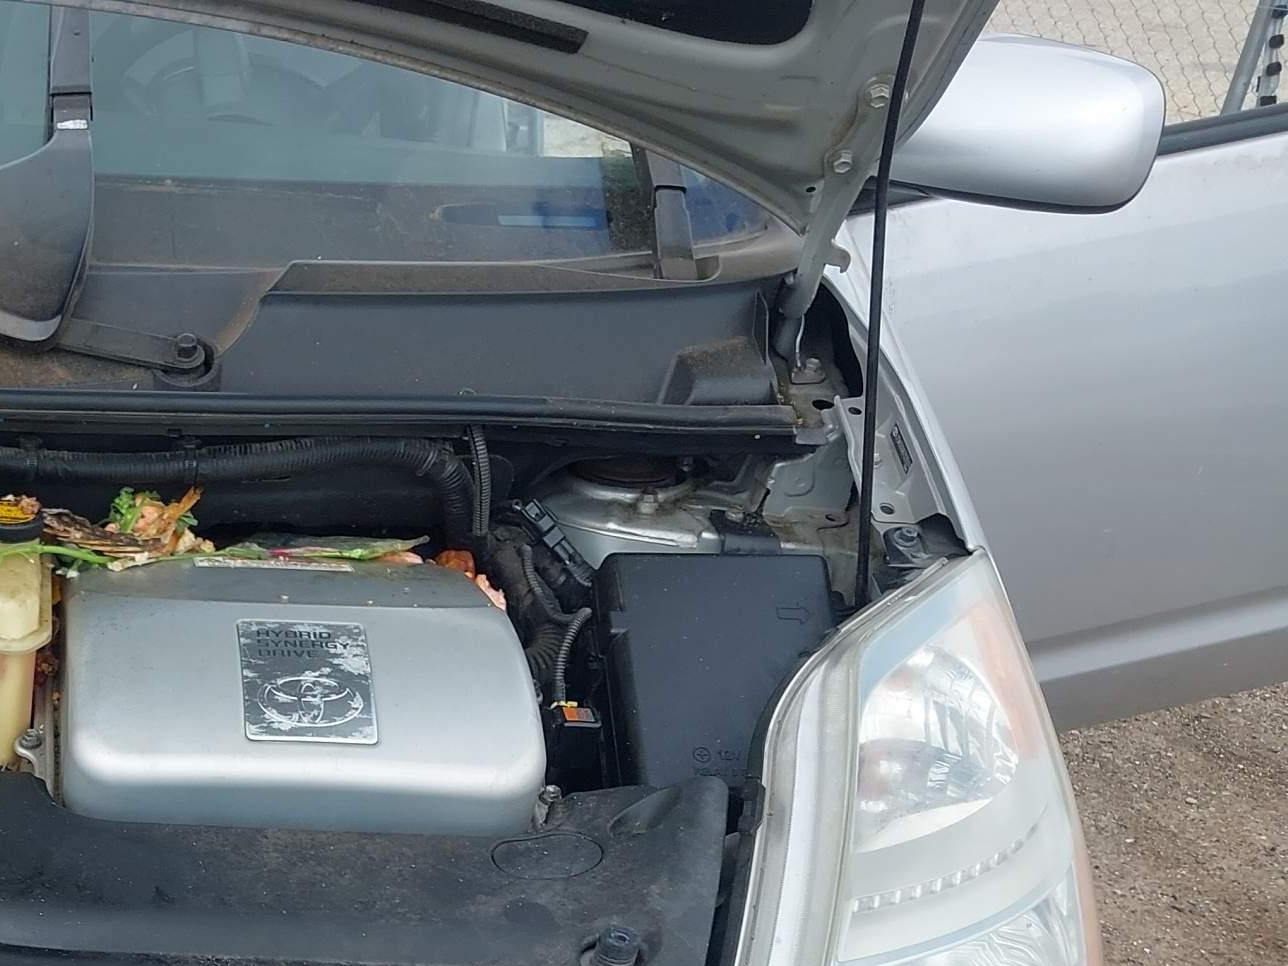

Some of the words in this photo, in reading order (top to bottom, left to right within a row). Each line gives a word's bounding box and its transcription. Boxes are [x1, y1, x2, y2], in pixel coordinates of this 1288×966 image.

[256, 630, 331, 639] HYBRID
[257, 639, 350, 649] SYNERGY
[258, 649, 318, 658] DRIVE
